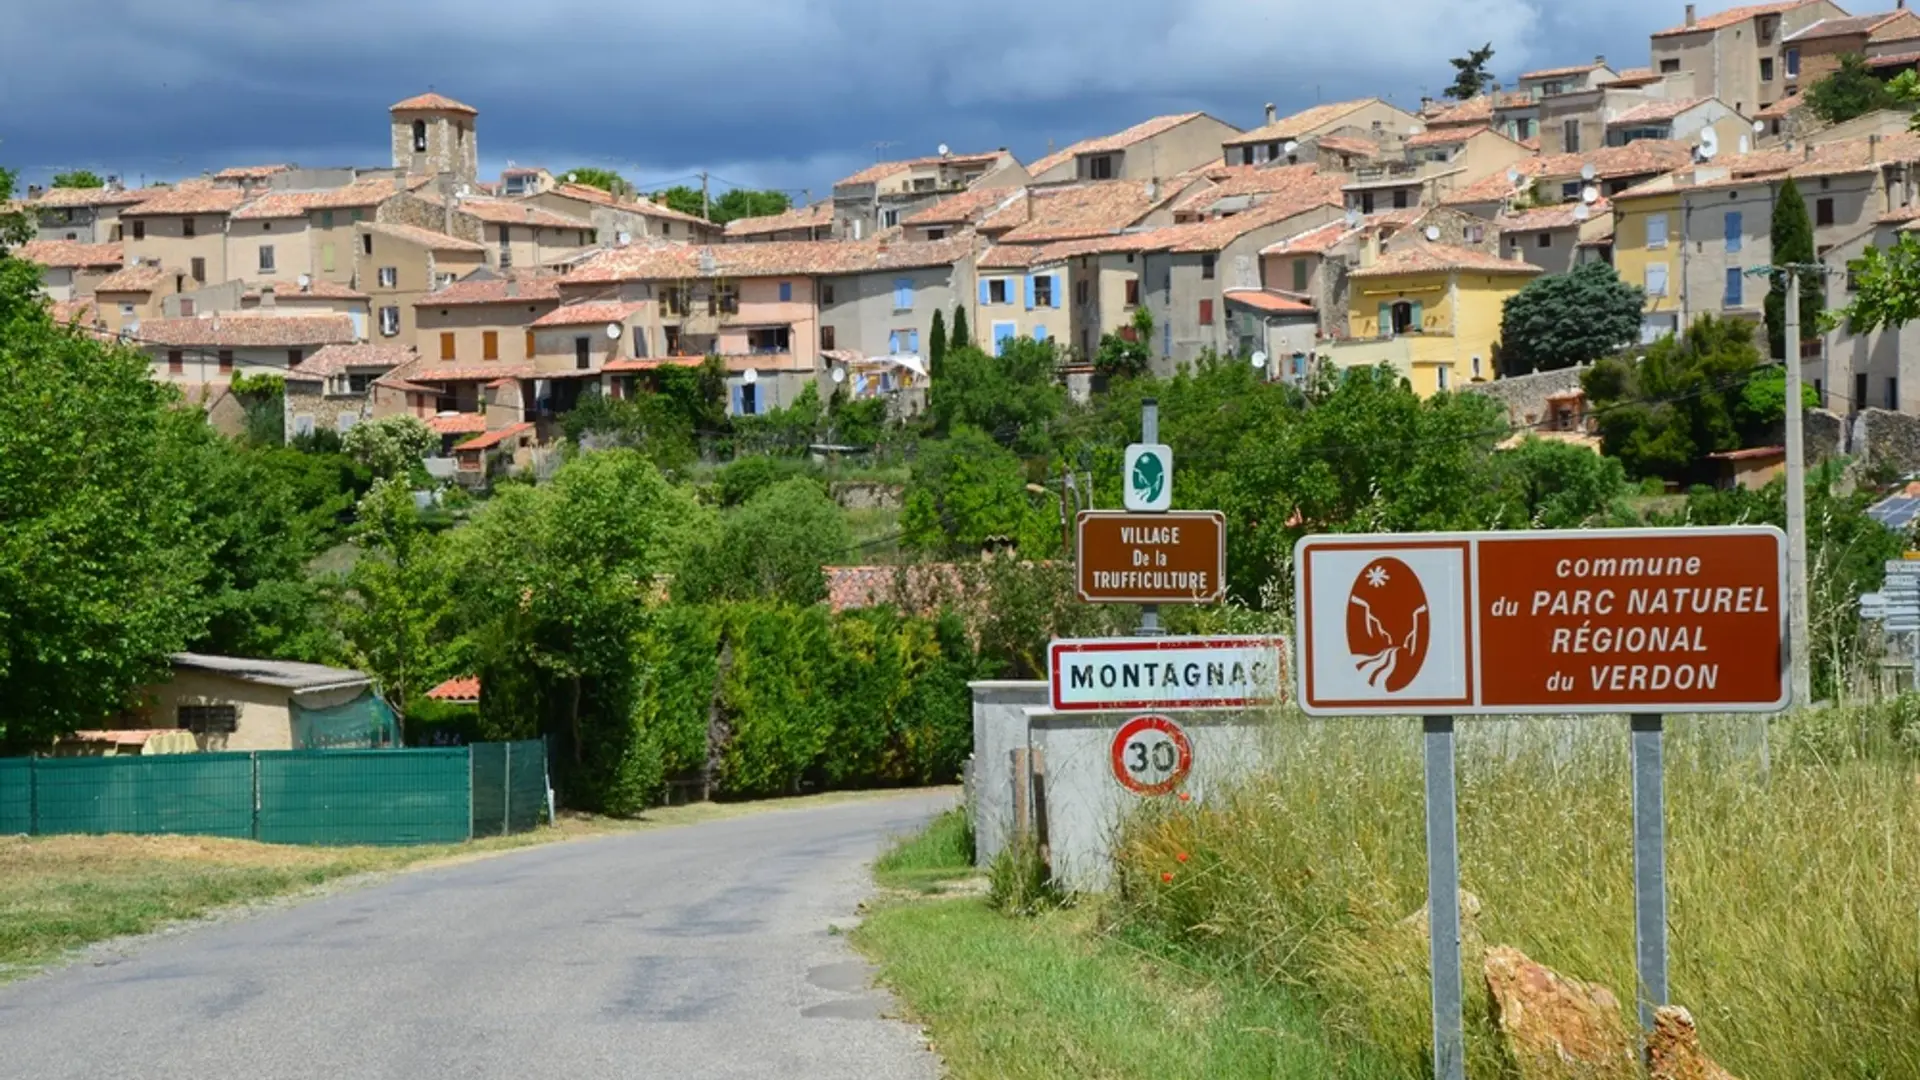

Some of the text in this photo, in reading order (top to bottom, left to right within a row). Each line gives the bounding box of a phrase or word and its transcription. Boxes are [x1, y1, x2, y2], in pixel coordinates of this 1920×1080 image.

[1121, 527, 1180, 544] VILLAGE
[1133, 549, 1167, 566] De la
[1556, 555, 1701, 577] commune
[1093, 571, 1208, 589] TRUFFICULTURE
[1491, 587, 1770, 617] du PARC NATUREL
[1551, 621, 1708, 653] RÉGIONAL
[1546, 664, 1719, 692] du VERDON
[1128, 740, 1175, 773] 30
